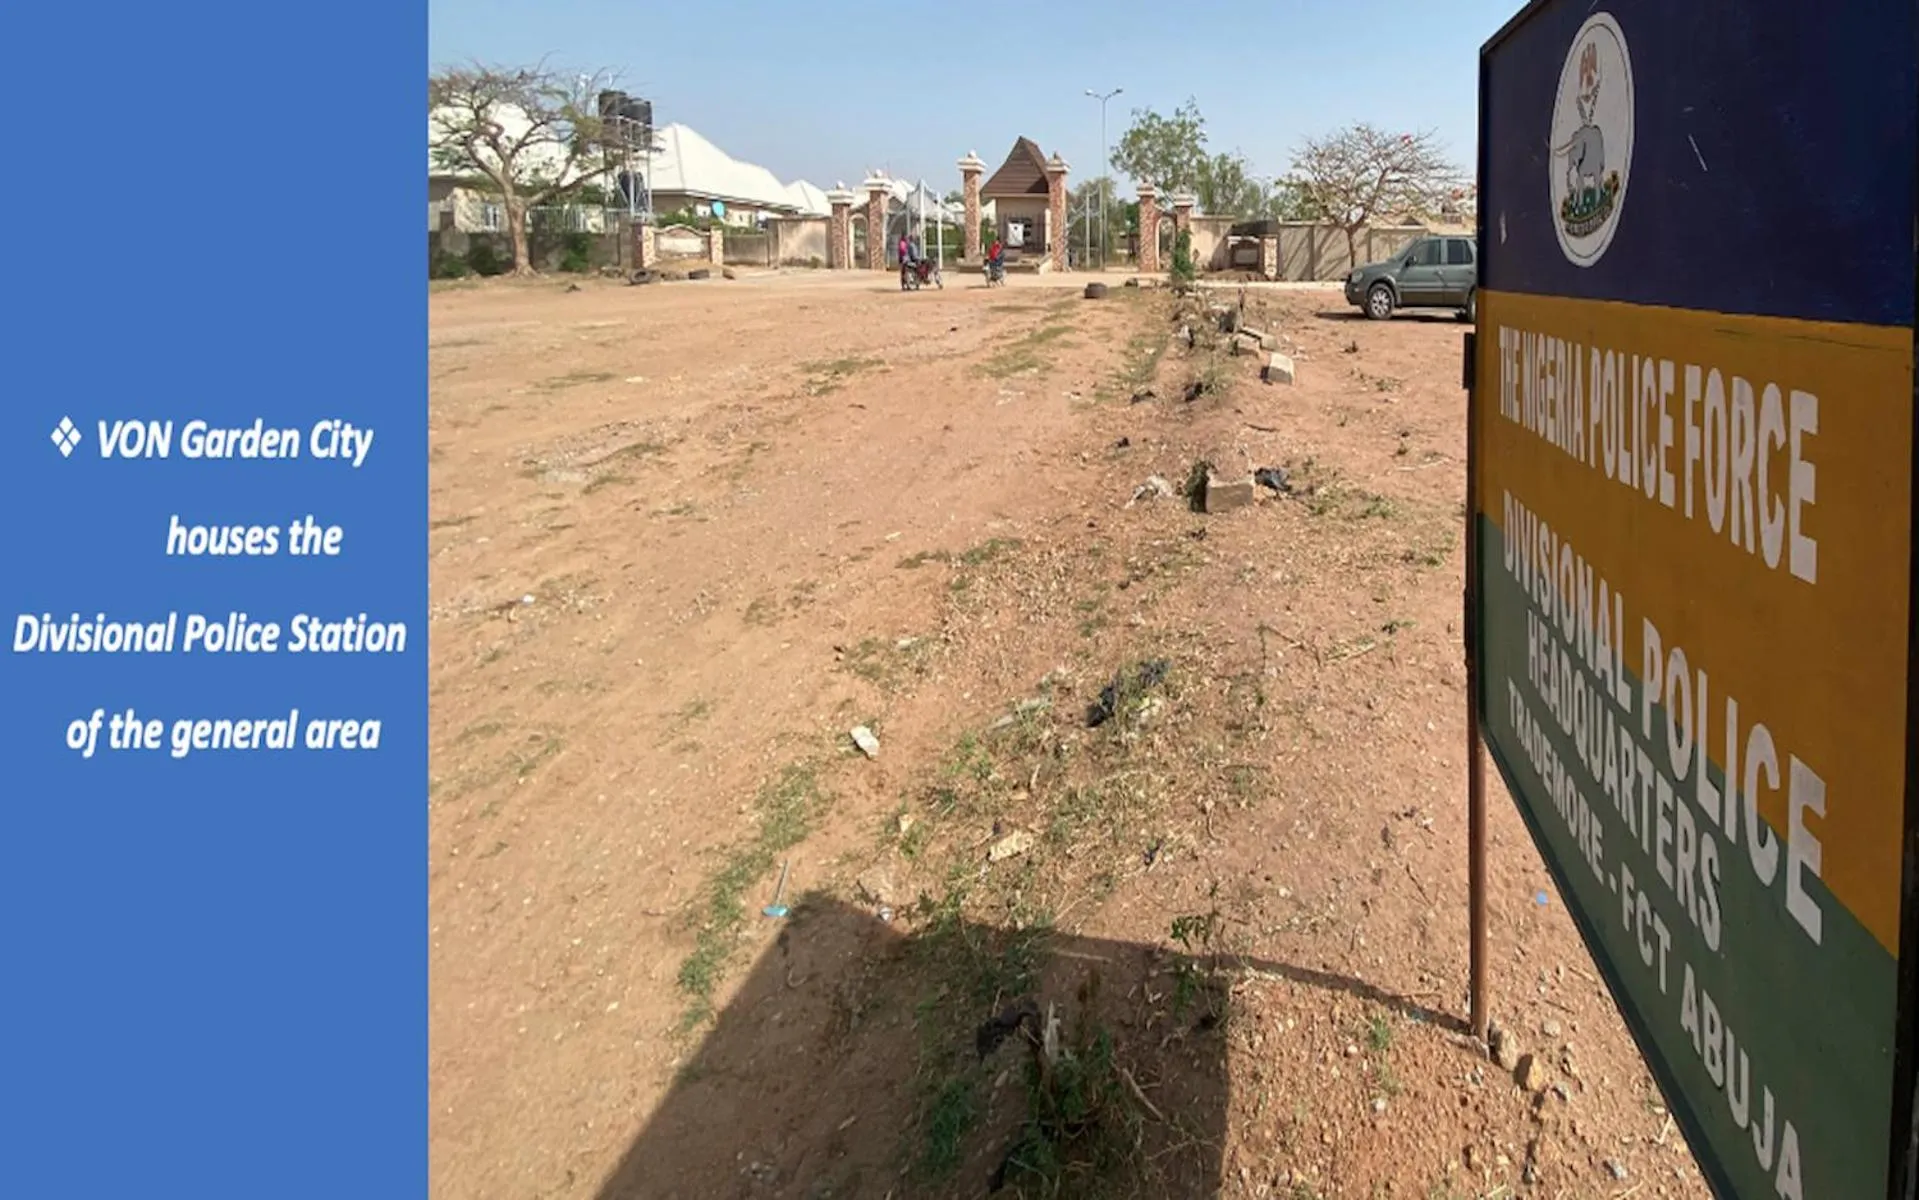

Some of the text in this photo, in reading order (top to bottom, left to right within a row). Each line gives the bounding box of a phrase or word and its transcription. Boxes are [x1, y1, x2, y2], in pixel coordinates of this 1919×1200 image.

[1499, 325, 1819, 585] THE NIGERIA POLICE FORCE
[1503, 488, 1827, 946] DIVISIONAL POLICE
[1527, 608, 1722, 952] HEADQUARTERS
[1680, 962, 1804, 1200] ABUJA
